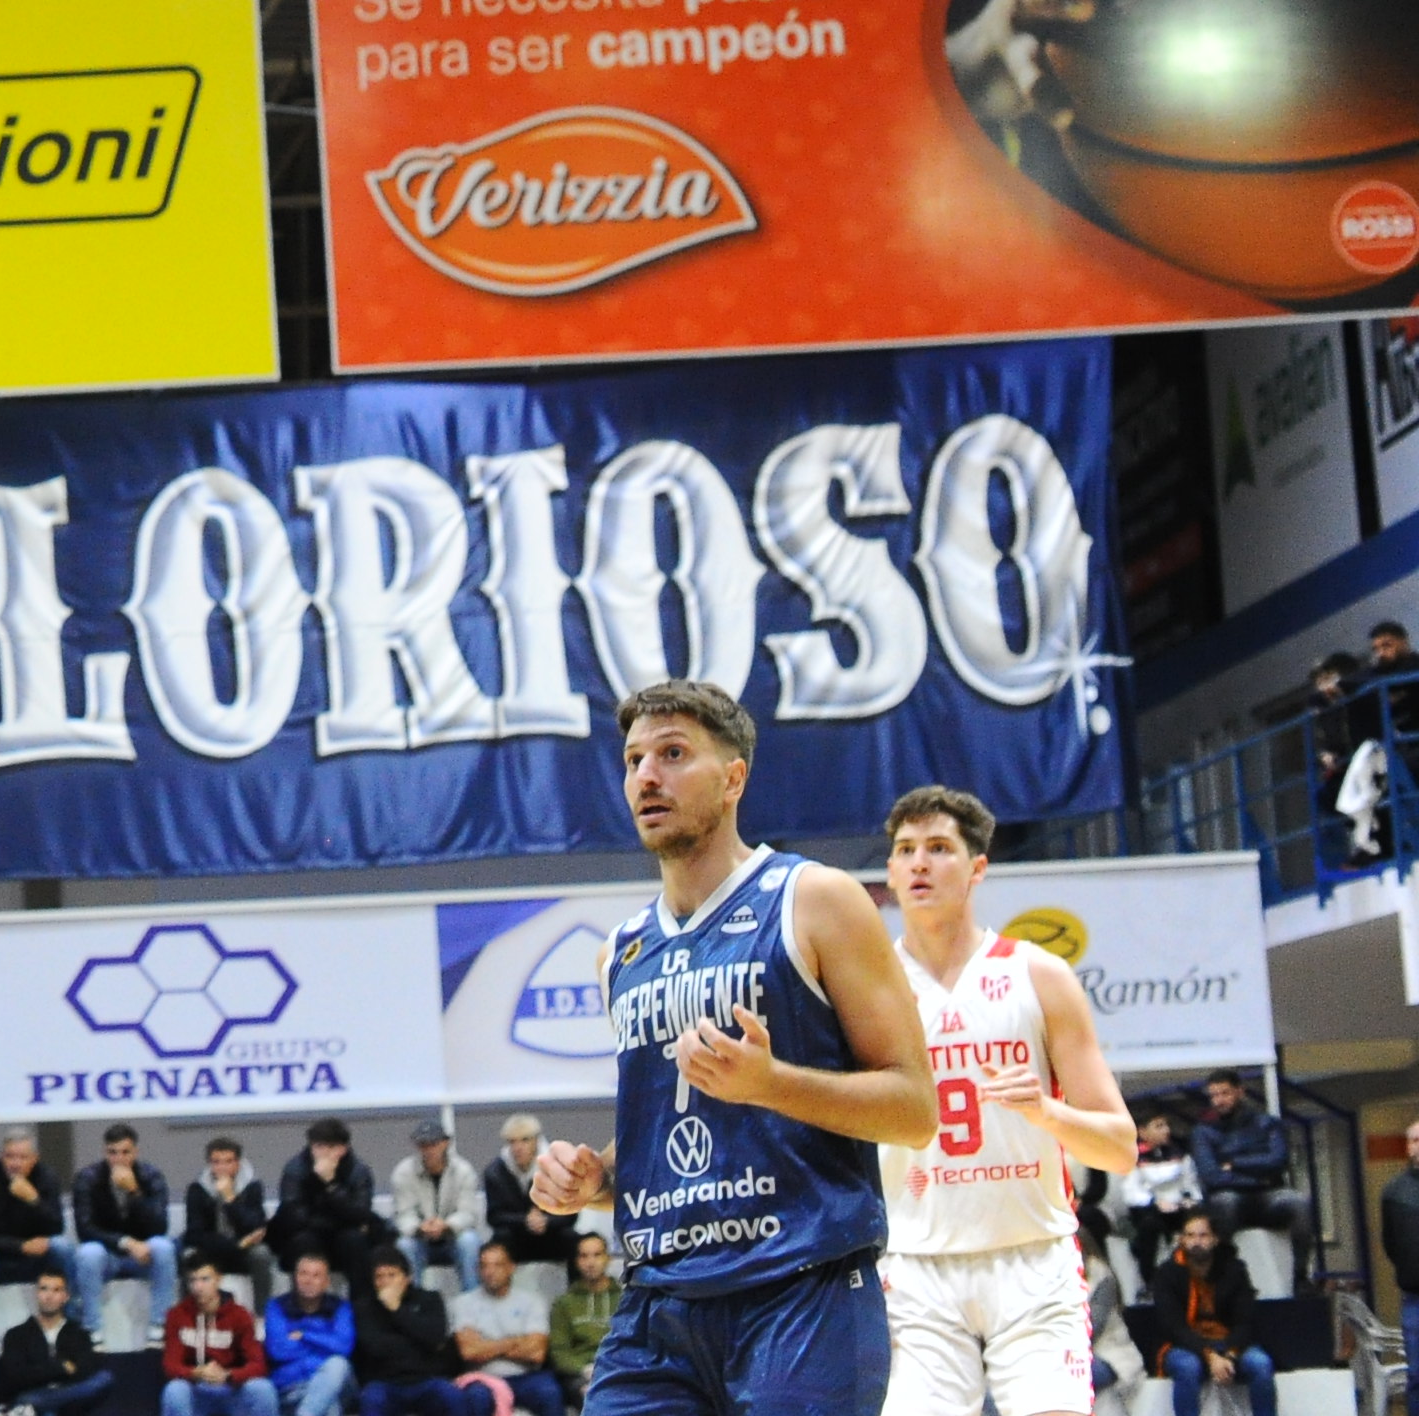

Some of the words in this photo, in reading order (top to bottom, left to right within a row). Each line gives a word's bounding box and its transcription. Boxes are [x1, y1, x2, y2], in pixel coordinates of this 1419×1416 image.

[356, 38, 469, 92] para
[488, 33, 570, 76] ser
[588, 9, 846, 74] campeón
[397, 155, 719, 237] Verizzia
[1342, 215, 1415, 239] ROSSI
[1077, 965, 1228, 1015] Ramón
[225, 1037, 347, 1061] GRUPO
[927, 1040, 1031, 1071] TITUTO
[27, 1062, 347, 1105] PIGNATTA
[937, 1077, 984, 1157] 9
[624, 1166, 777, 1219] Veneranda
[931, 1161, 1041, 1185] Tecnored
[659, 1214, 781, 1255] ECONOVO
